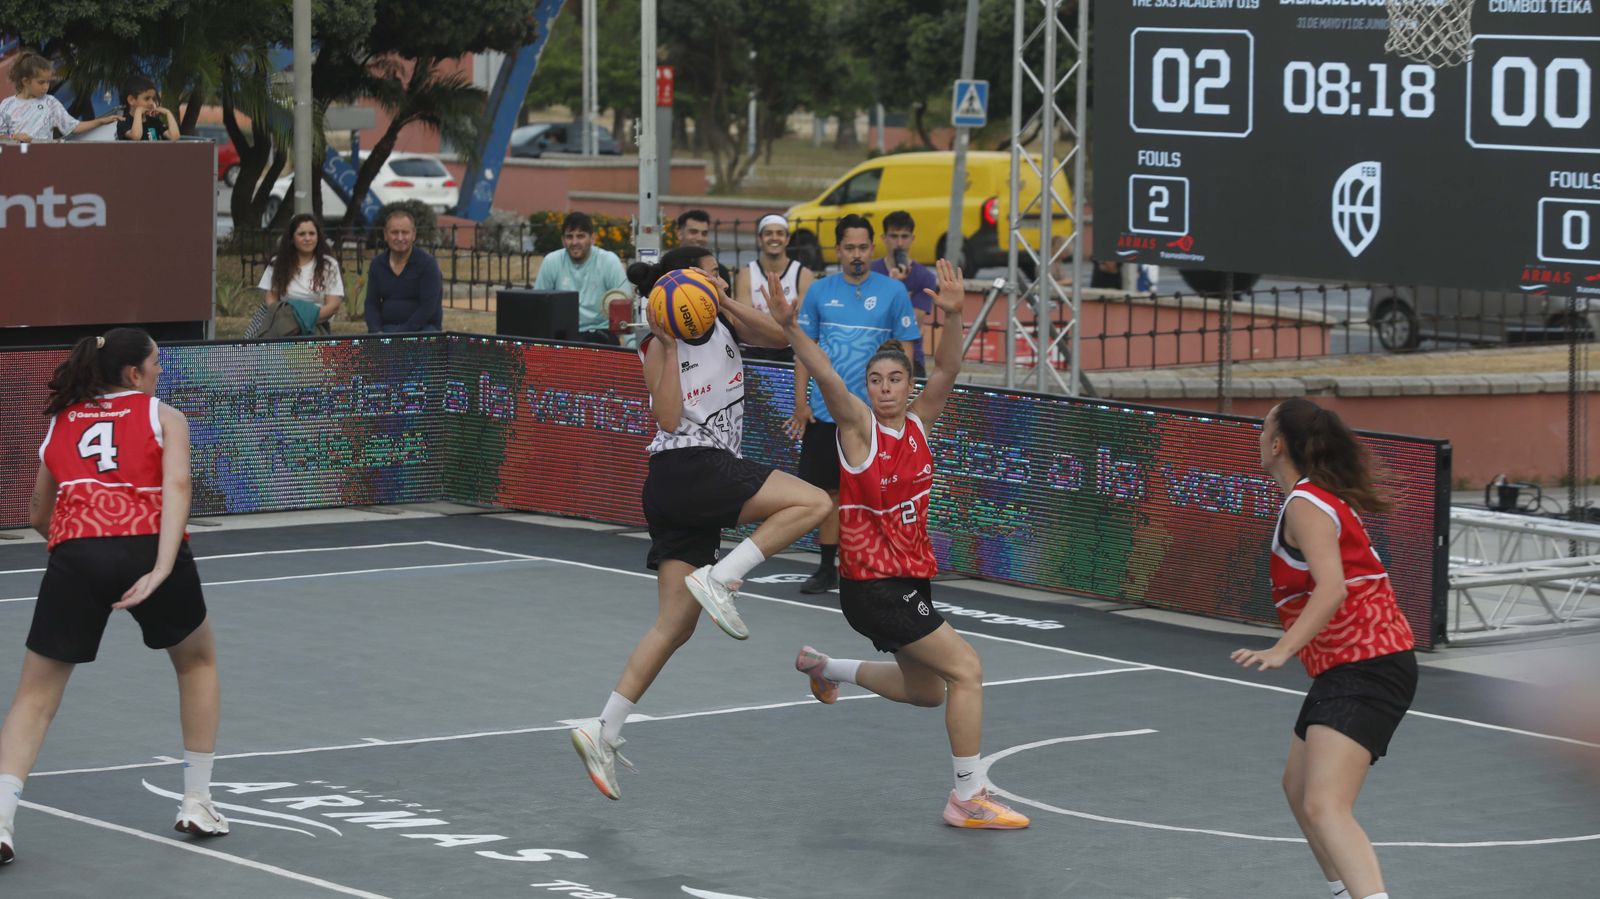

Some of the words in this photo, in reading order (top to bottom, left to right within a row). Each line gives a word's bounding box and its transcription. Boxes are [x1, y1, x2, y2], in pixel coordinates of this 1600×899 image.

[1488, 0, 1547, 13] COMBOI
[1550, 0, 1593, 14] TEIKA
[1152, 48, 1231, 116] 02
[1283, 61, 1436, 119] 08:18
[1491, 56, 1591, 129] 00
[1138, 150, 1182, 168] FOULS
[1549, 171, 1600, 190] FOULS
[1149, 185, 1170, 223] 2
[1117, 234, 1158, 250] ARMAS
[1562, 210, 1590, 251] 0
[1521, 269, 1571, 285] ARMAS
[683, 384, 713, 402] RMAS
[714, 407, 731, 433] 4
[77, 421, 119, 475] 4
[901, 499, 918, 526] 2
[208, 781, 590, 862] ARMAS
